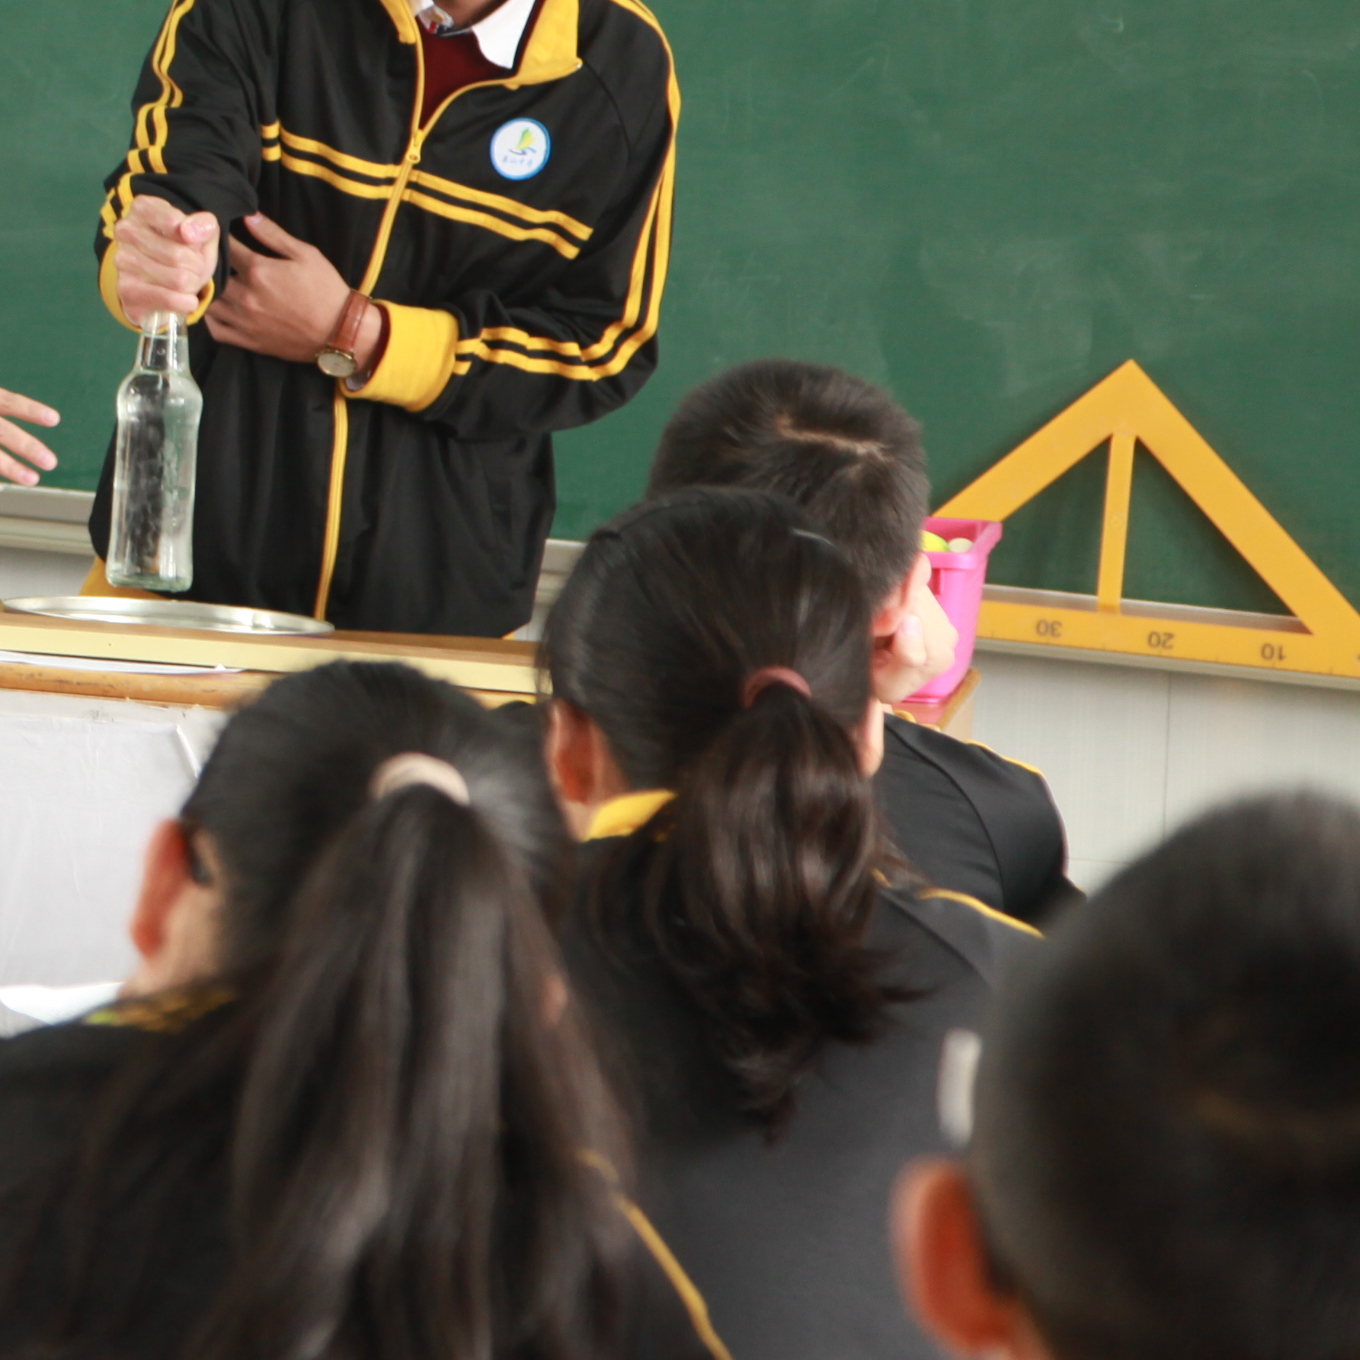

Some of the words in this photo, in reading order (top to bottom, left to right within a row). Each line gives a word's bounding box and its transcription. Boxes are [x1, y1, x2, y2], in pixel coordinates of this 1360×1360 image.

[1035, 618, 1063, 638] 30
[1147, 630, 1175, 650] 20
[1260, 642, 1287, 661] 10
